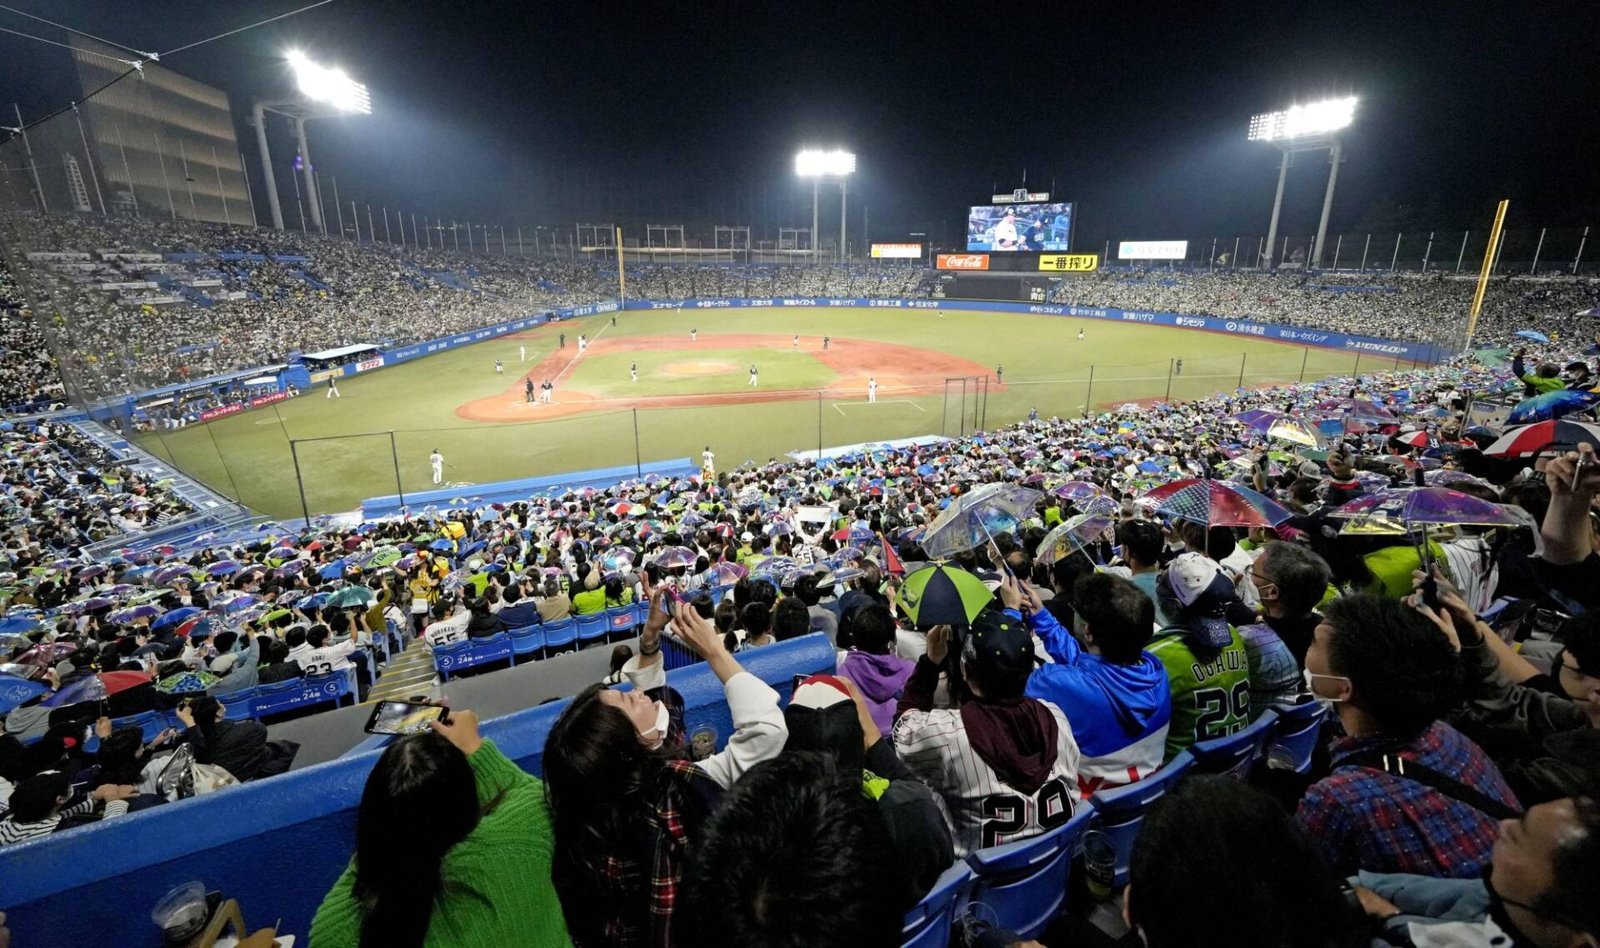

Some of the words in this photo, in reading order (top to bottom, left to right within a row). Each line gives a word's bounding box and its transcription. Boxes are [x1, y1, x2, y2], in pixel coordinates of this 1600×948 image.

[1043, 256, 1094, 269] 一番搾り
[1237, 323, 1265, 335] 清水建設
[1354, 341, 1408, 354] DUNLOP
[305, 662, 332, 675] 23
[1193, 678, 1250, 740] 29
